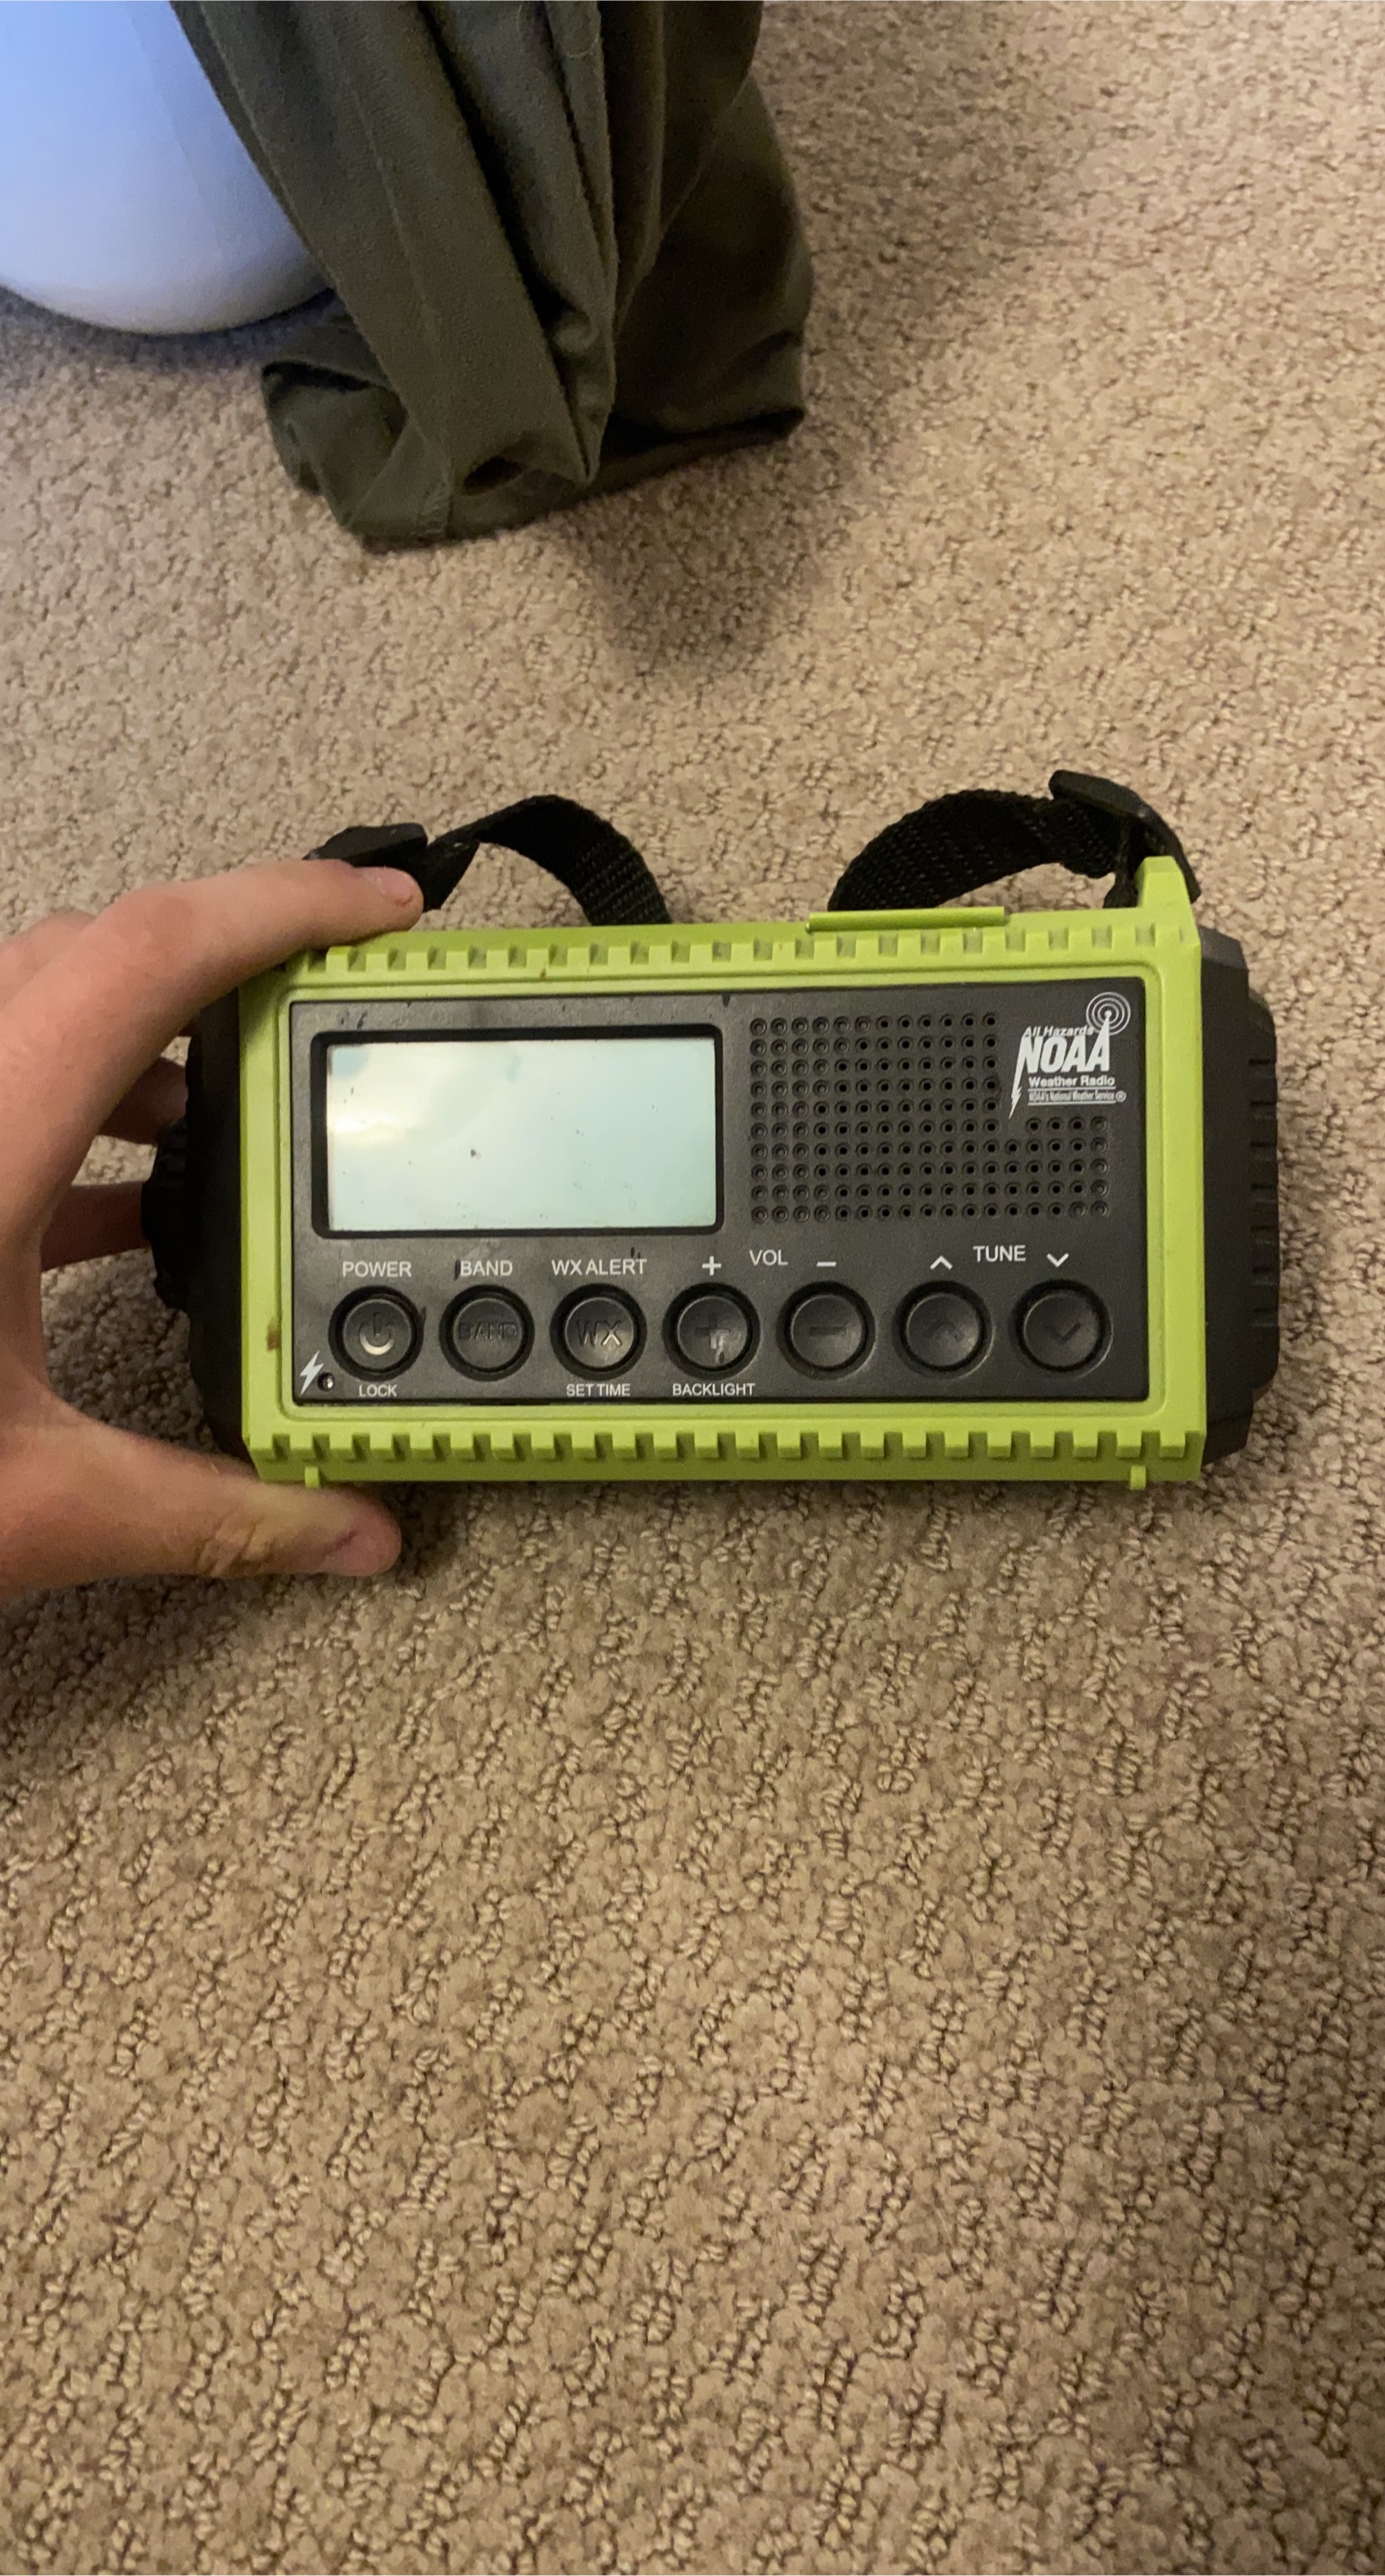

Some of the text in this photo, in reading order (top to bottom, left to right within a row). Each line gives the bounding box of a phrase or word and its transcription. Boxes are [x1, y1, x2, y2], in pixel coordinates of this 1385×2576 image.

[1023, 1025, 1094, 1037] All Hazards
[1013, 1033, 1110, 1073] NOAA
[1029, 1075, 1116, 1088] Weather Radio
[749, 1250, 788, 1267] VOL
[973, 1245, 1027, 1263] TUNE
[342, 1260, 412, 1279] POWER
[459, 1259, 514, 1277] BAND
[551, 1258, 648, 1277] WX ALERT
[458, 1322, 519, 1342] BAND
[577, 1320, 624, 1347] WX
[358, 1384, 397, 1398] LOCK
[565, 1383, 632, 1397] SET TIME
[672, 1382, 756, 1397] BACKLIGHT
